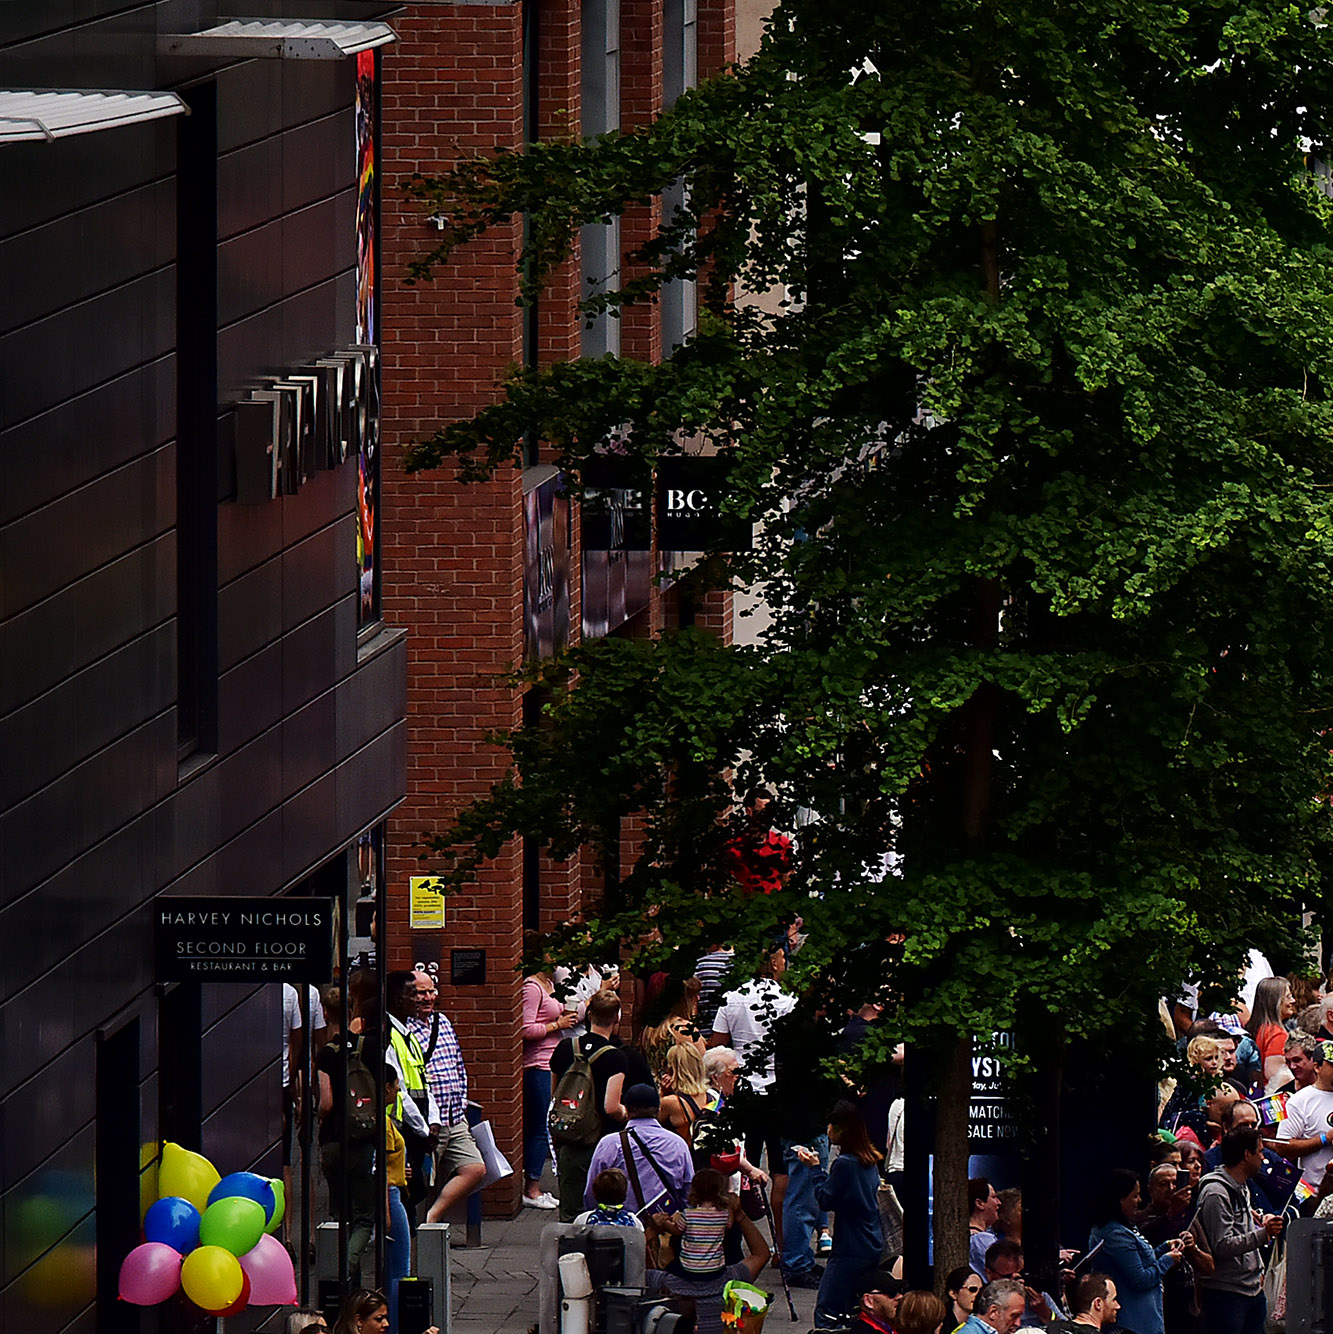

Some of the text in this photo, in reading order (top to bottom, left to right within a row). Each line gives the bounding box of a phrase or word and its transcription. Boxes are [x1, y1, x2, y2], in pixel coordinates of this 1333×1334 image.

[161, 912, 322, 926] HARVEY NICHOLS
[177, 941, 306, 955] SECOND FLOOR
[190, 962, 292, 971] RESTAURANT & BAR
[967, 1124, 994, 1138] SALE
